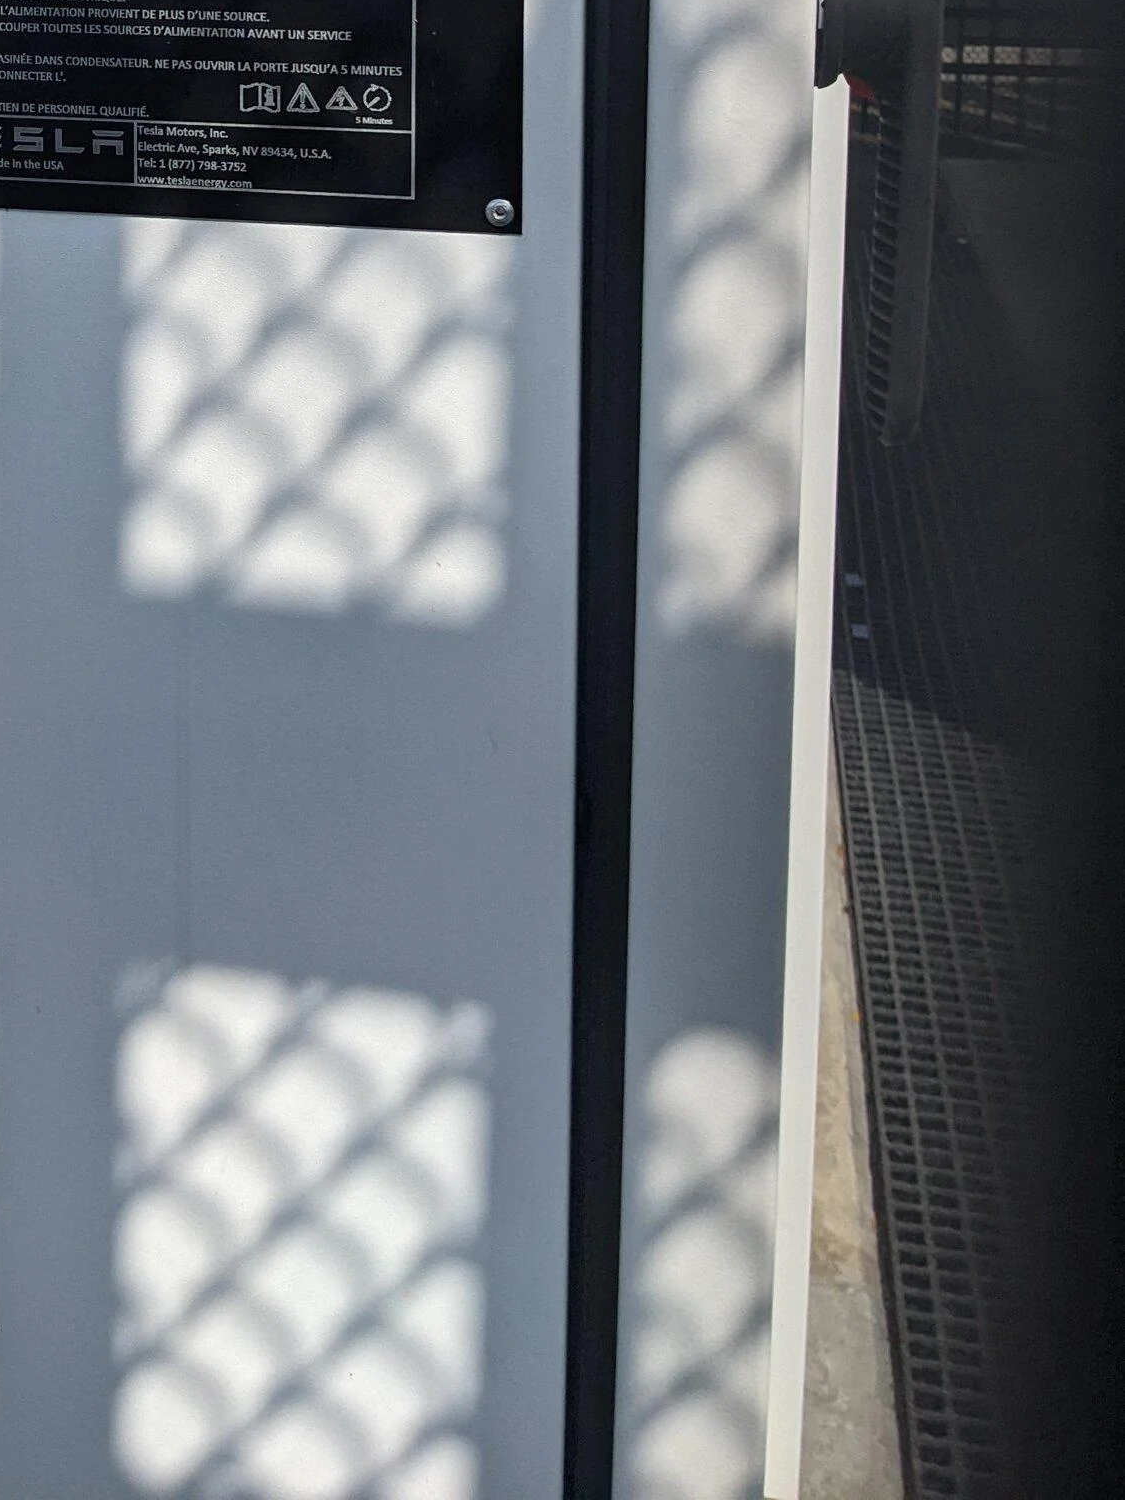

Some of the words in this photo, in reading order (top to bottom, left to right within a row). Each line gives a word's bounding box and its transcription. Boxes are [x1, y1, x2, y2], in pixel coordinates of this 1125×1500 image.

[137, 123, 163, 135] Tesla
[166, 126, 207, 138] Motors,
[209, 127, 228, 138] Inc.
[137, 142, 175, 152] Electric
[176, 143, 200, 155] Ave,
[201, 144, 240, 156] Sparks,
[241, 145, 259, 156] NV
[260, 146, 297, 159] 89434,
[299, 148, 331, 159] U.S.A.
[12, 158, 21, 168] in
[23, 158, 41, 169] the
[43, 160, 64, 170] USA
[137, 158, 156, 168] Tel:
[167, 158, 195, 171] (877)
[196, 160, 247, 172] 798-3752
[137, 174, 252, 189] www.teslaenergy.com
